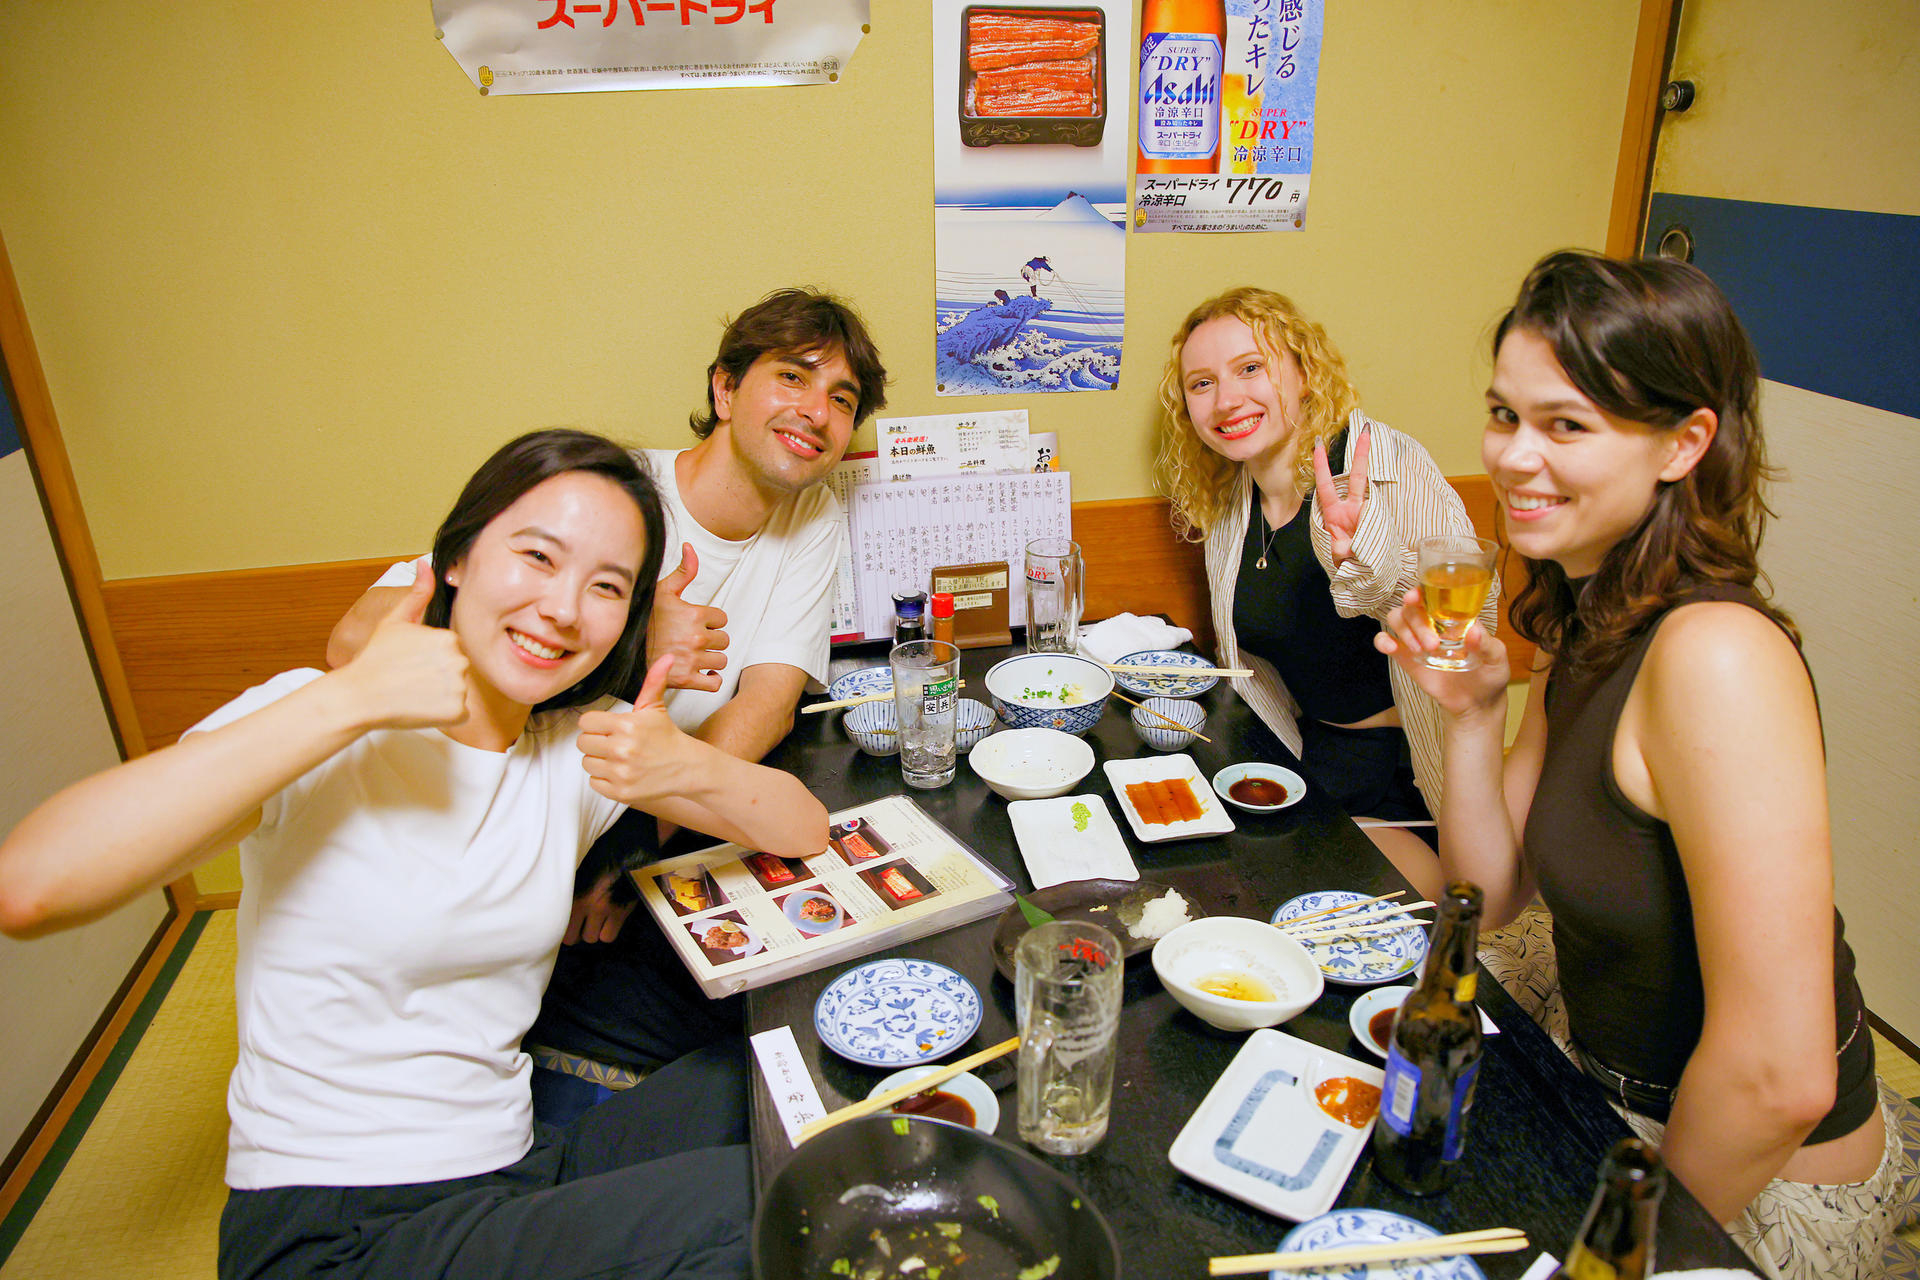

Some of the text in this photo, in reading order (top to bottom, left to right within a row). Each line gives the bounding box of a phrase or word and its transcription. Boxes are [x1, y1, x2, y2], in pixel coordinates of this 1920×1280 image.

[1276, 0, 1304, 78] 感じる
[1144, 73, 1215, 105] Asahi
[1251, 107, 1287, 118] SUPER
[1156, 131, 1202, 139] スーパードライ
[1232, 145, 1302, 163] 冷涼辛口
[1144, 178, 1220, 191] スーパードライ
[1226, 177, 1283, 206] 770
[1138, 193, 1187, 207] 冷涼辛口
[889, 443, 937, 458] 本日の鮮魚
